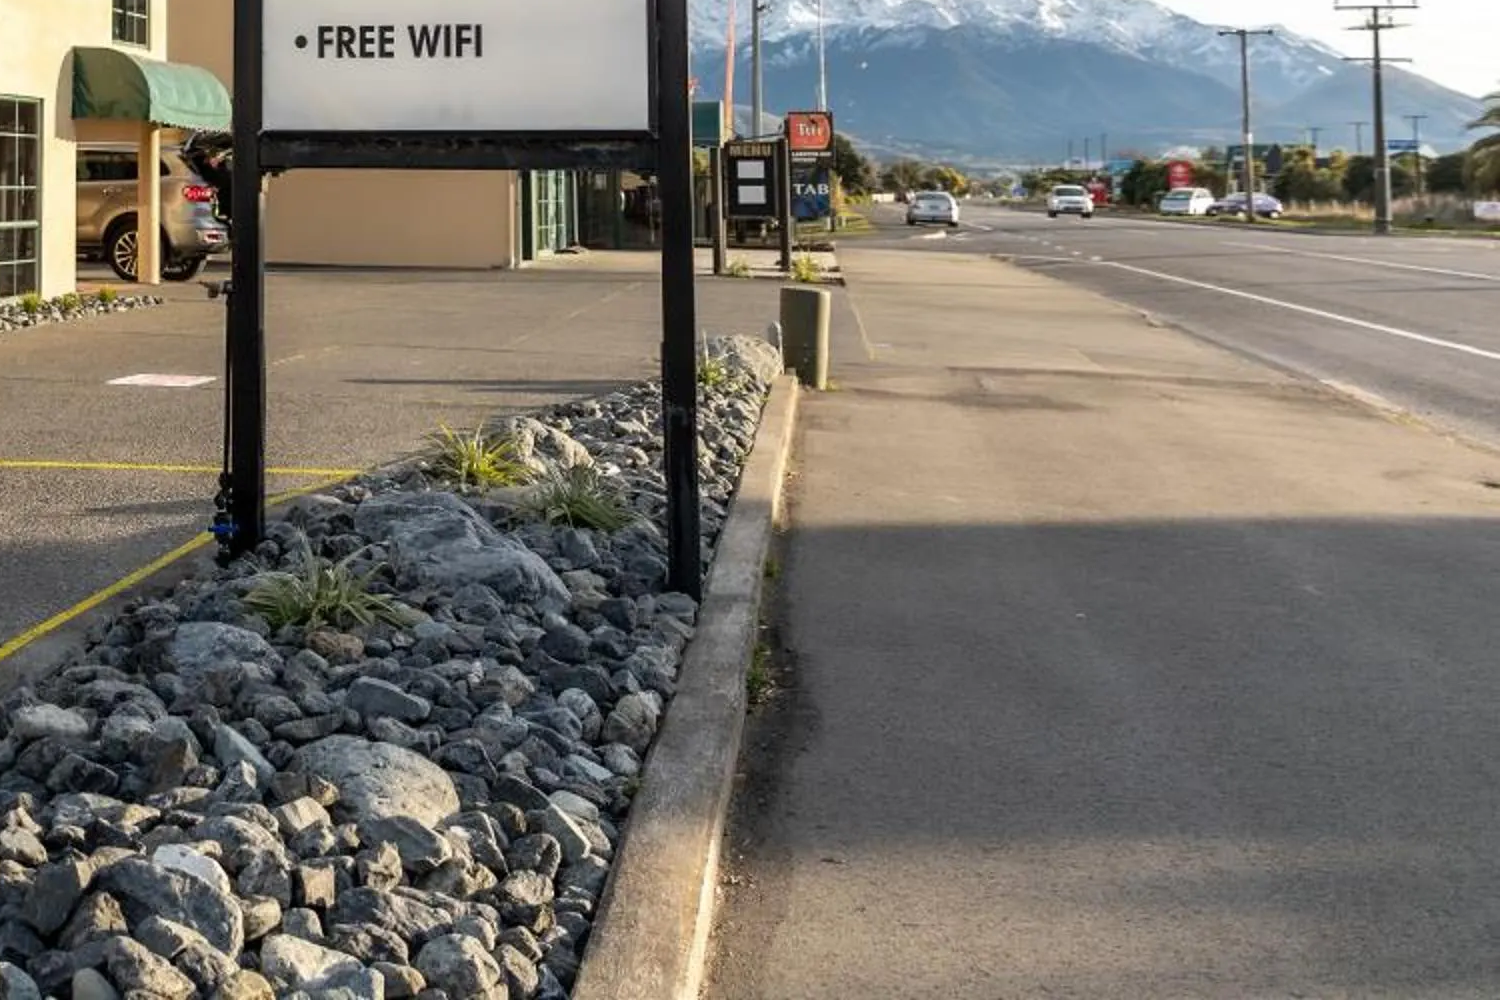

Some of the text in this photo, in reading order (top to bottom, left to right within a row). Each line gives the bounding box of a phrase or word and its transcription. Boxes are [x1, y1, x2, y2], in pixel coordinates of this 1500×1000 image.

[317, 23, 483, 59] FREE WIFI
[729, 143, 772, 157] MENU
[793, 183, 829, 196] TAB
